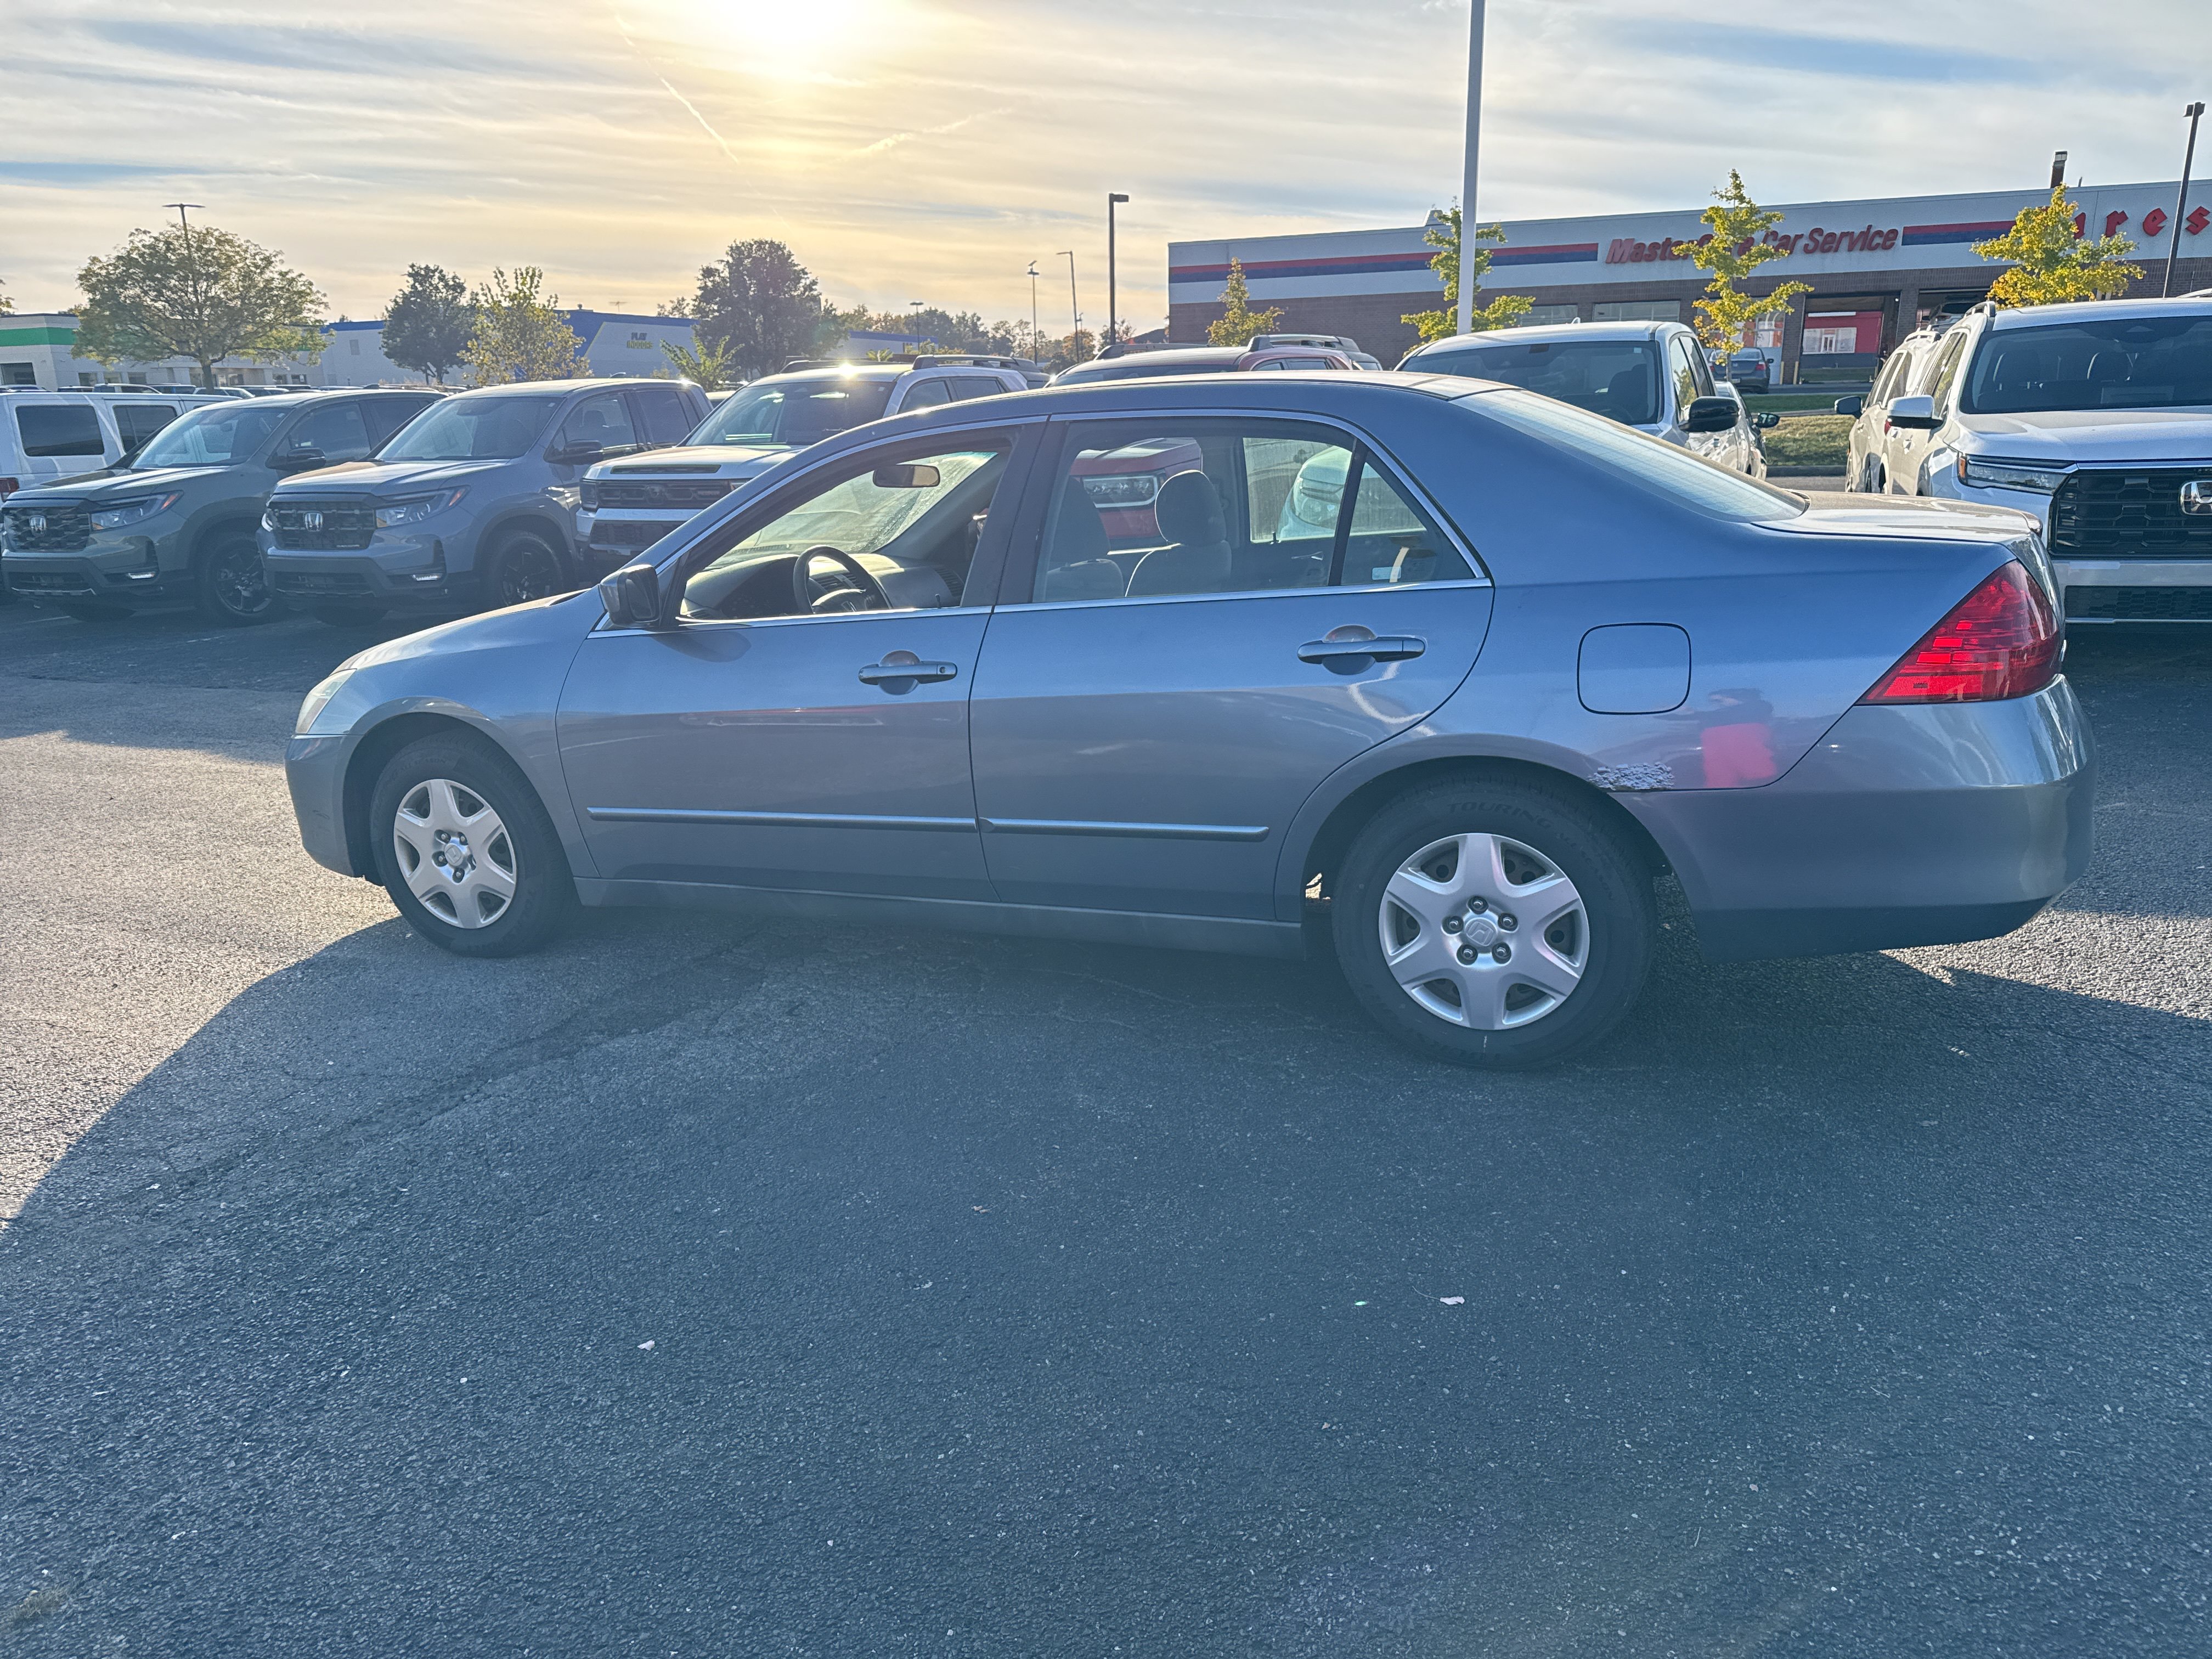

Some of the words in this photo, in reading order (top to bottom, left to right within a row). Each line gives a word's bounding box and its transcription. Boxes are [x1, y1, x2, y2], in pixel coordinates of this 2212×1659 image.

[1760, 230, 1804, 255] Car
[1804, 224, 1899, 253] Service
[631, 332, 647, 340] PLAY
[1447, 802, 1554, 828] TOURING
